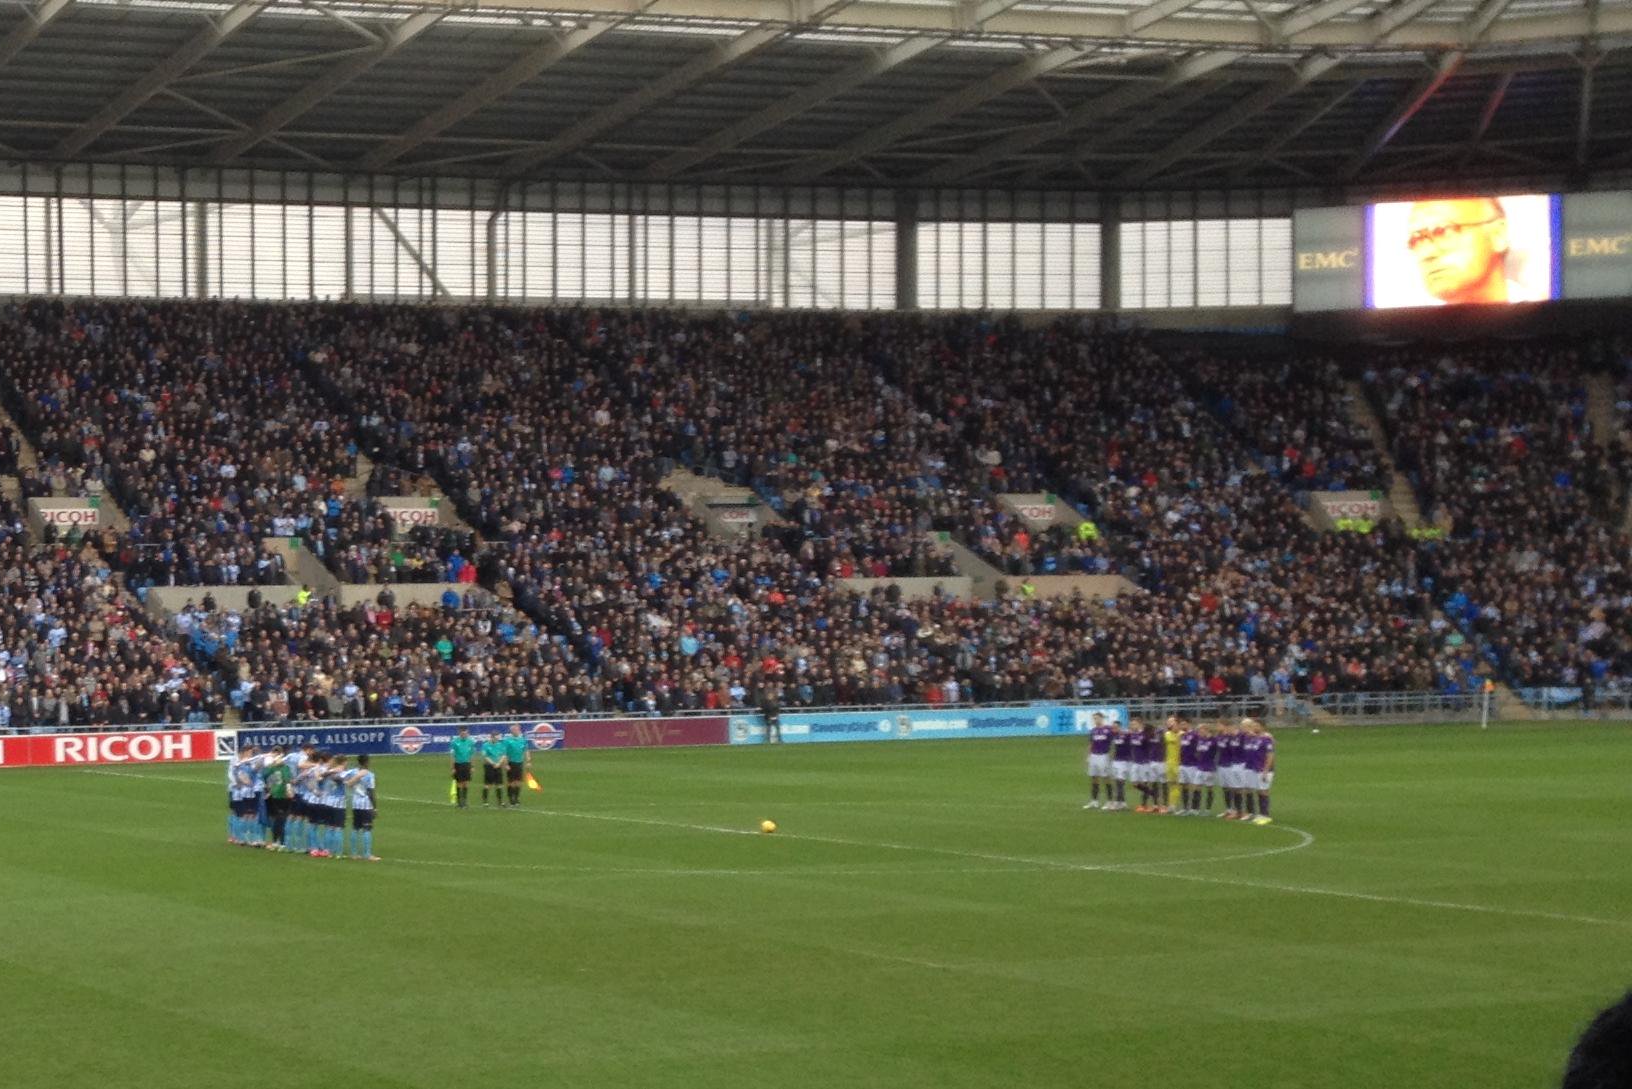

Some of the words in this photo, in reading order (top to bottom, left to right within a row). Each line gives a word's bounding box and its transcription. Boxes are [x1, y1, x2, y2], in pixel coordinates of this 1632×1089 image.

[53, 734, 192, 763] RICOH
[244, 735, 304, 746] ALLSOPP
[309, 734, 319, 745] &
[325, 732, 384, 744] ALLSOPP
